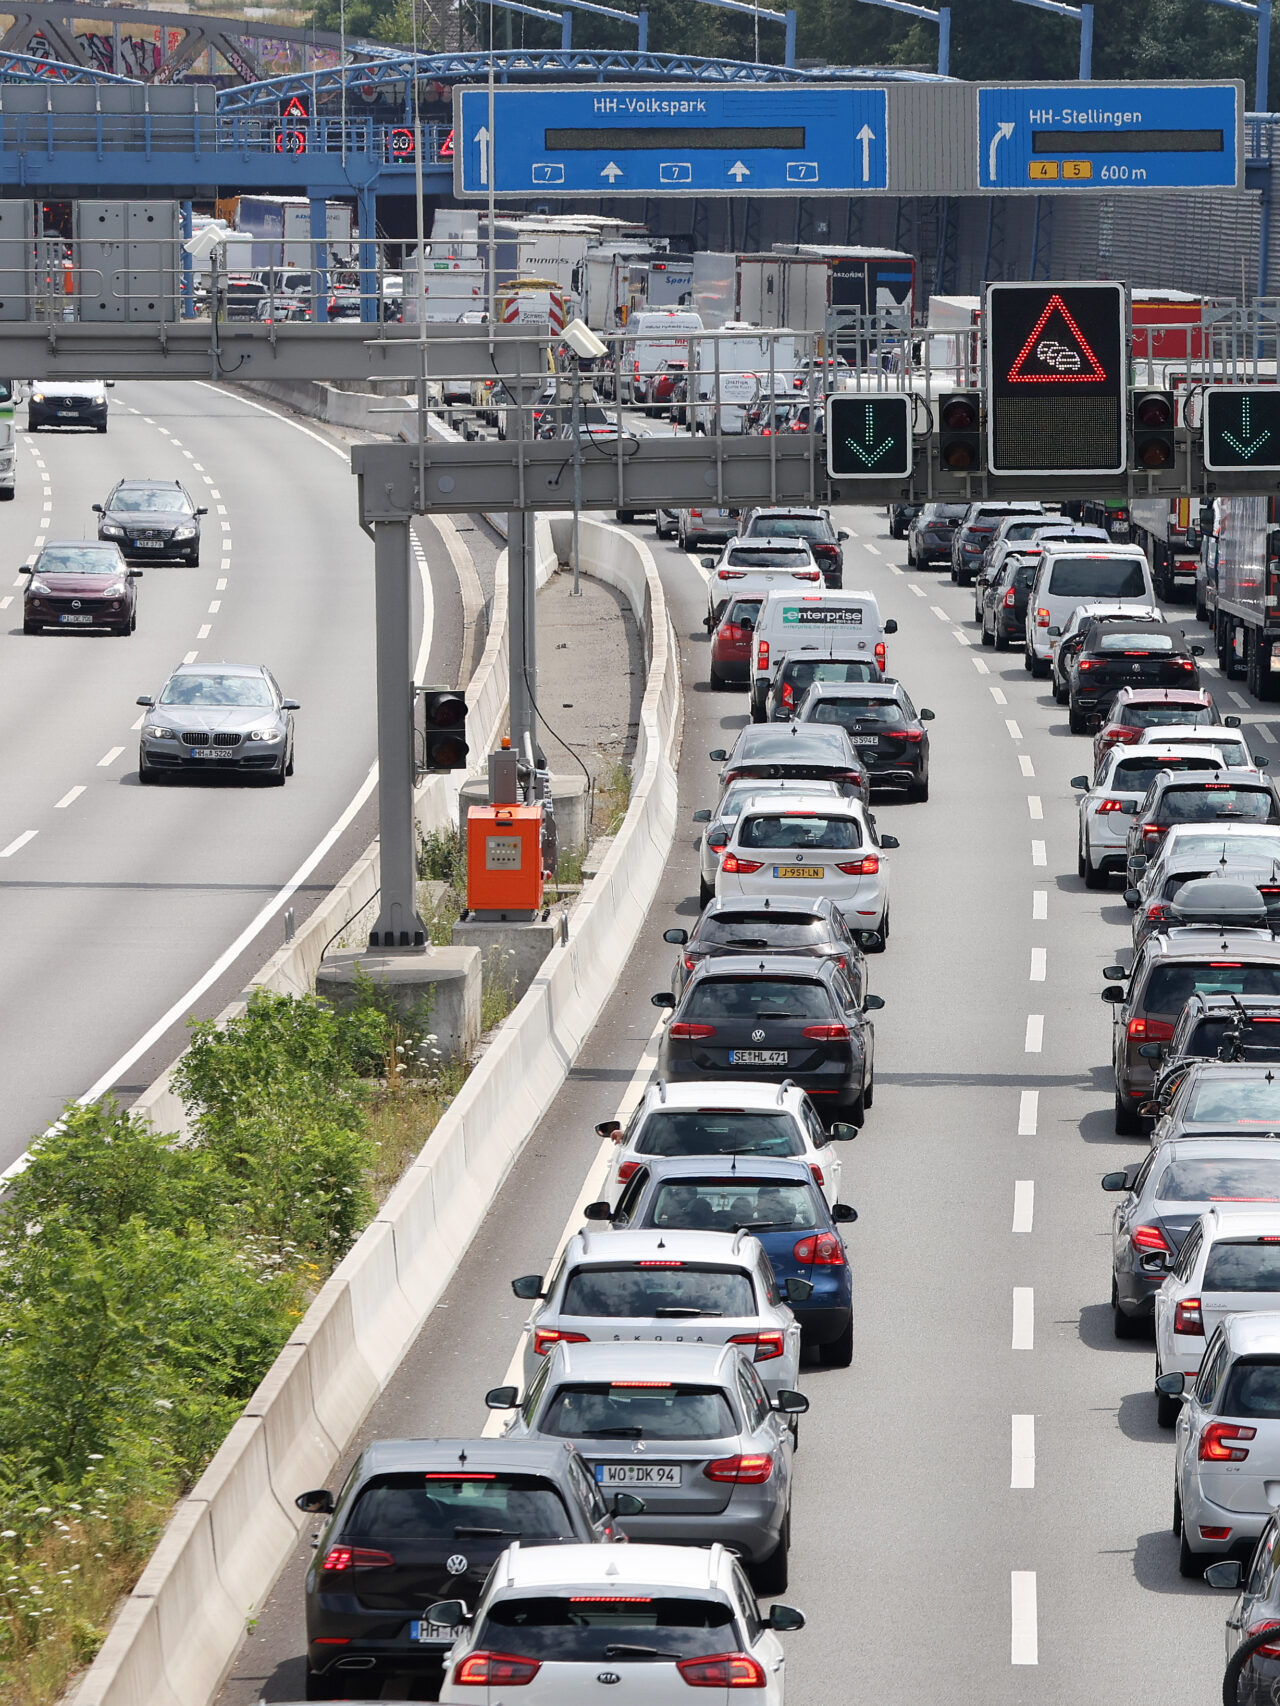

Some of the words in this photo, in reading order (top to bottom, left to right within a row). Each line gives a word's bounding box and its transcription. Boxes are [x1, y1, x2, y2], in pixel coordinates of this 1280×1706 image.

[593, 98, 707, 116] HH-Volkspark
[1029, 109, 1142, 126] HH-Stellingen
[544, 166, 552, 180] 7
[672, 166, 679, 180] 7
[799, 166, 807, 179] 7
[1040, 165, 1048, 175] 4
[1073, 165, 1081, 175] 5
[1101, 165, 1128, 180] 600
[1132, 168, 1147, 180] m
[785, 610, 862, 622] enterprise
[734, 1051, 747, 1062] SE
[753, 1051, 767, 1062] HL
[769, 1052, 787, 1062] 471
[608, 1467, 627, 1481] WO
[635, 1468, 654, 1481] DK
[657, 1468, 674, 1481] 94
[599, 1674, 617, 1682] KIA
